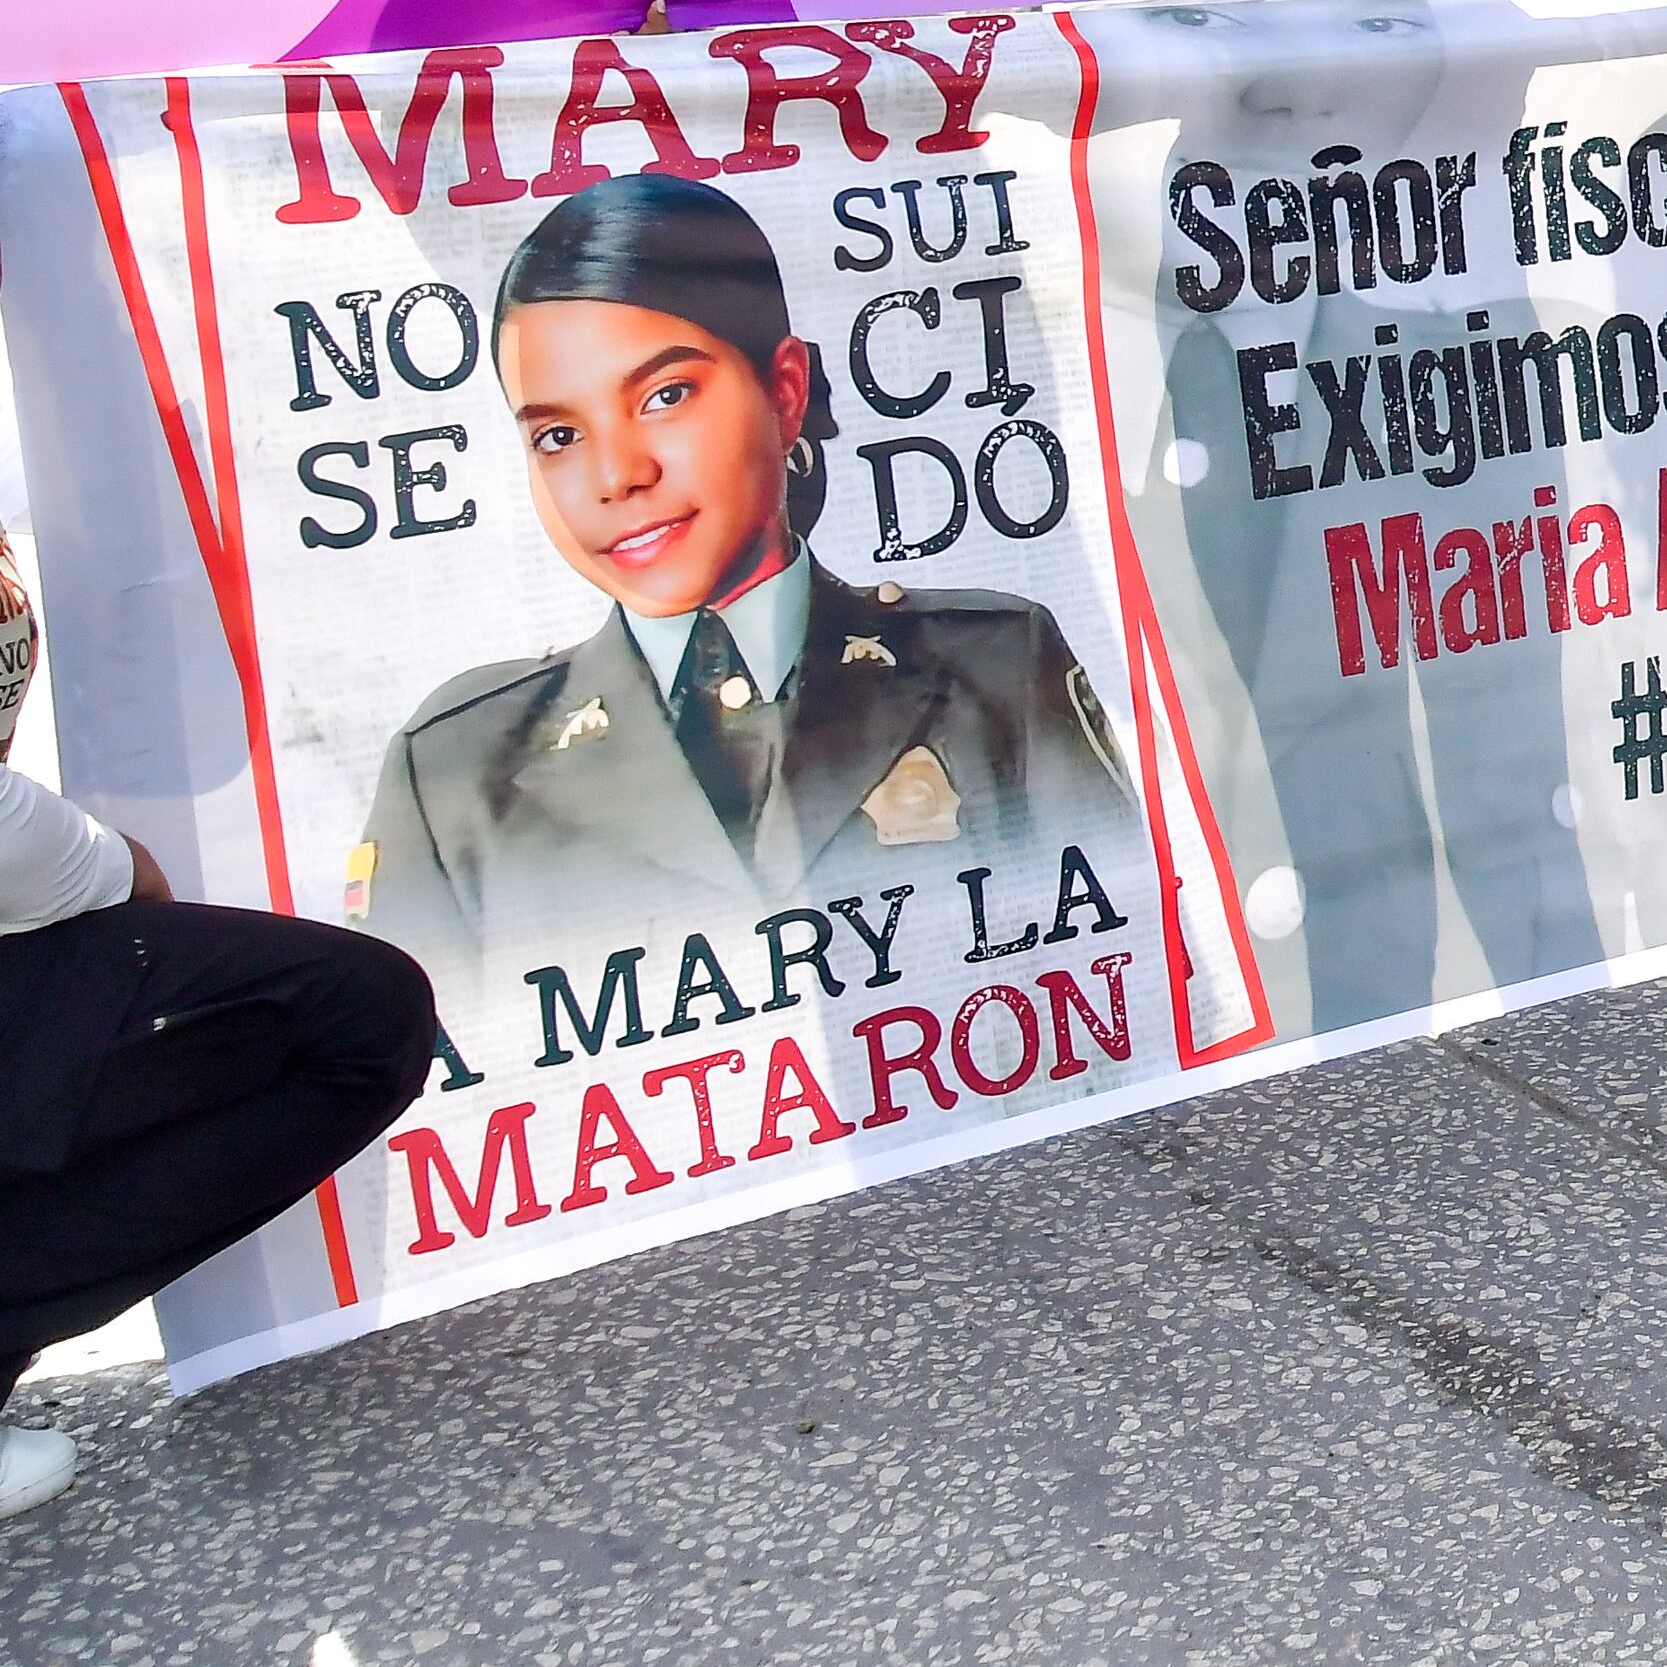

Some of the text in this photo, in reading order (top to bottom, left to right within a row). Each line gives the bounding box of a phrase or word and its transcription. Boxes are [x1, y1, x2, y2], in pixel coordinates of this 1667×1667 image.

[248, 14, 1017, 227] MARY
[275, 169, 1032, 412] NO SUI
[1169, 143, 1478, 315] Señor
[299, 423, 478, 552] SE
[1320, 485, 1634, 680] Maria
[523, 883, 915, 1068] MARY
[955, 843, 1129, 964] LA
[387, 951, 1135, 1257] MATARON
